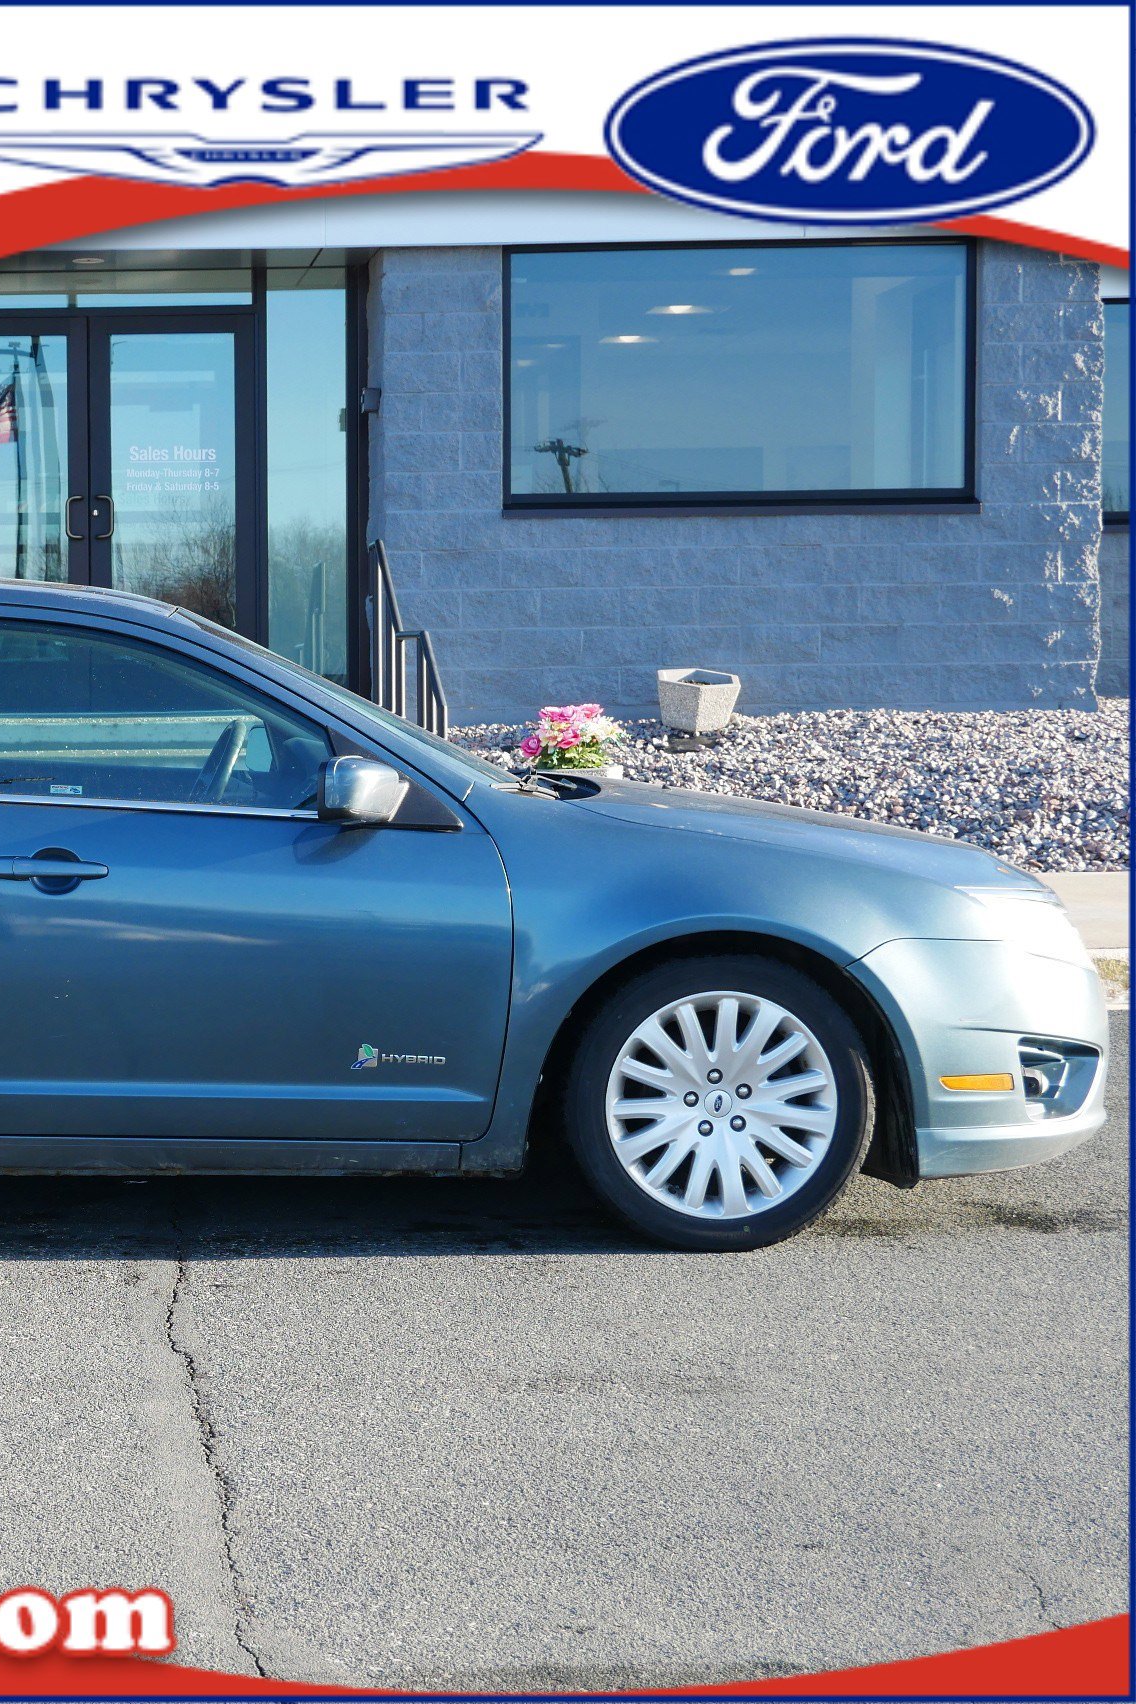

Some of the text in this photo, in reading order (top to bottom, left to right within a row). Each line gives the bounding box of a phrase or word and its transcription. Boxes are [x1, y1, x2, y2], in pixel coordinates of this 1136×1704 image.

[129, 445, 217, 461] Sales Hours
[204, 468, 220, 478] 8-7
[126, 481, 219, 492] Friday & Saturday 8-5
[381, 1053, 446, 1066] HYBRID
